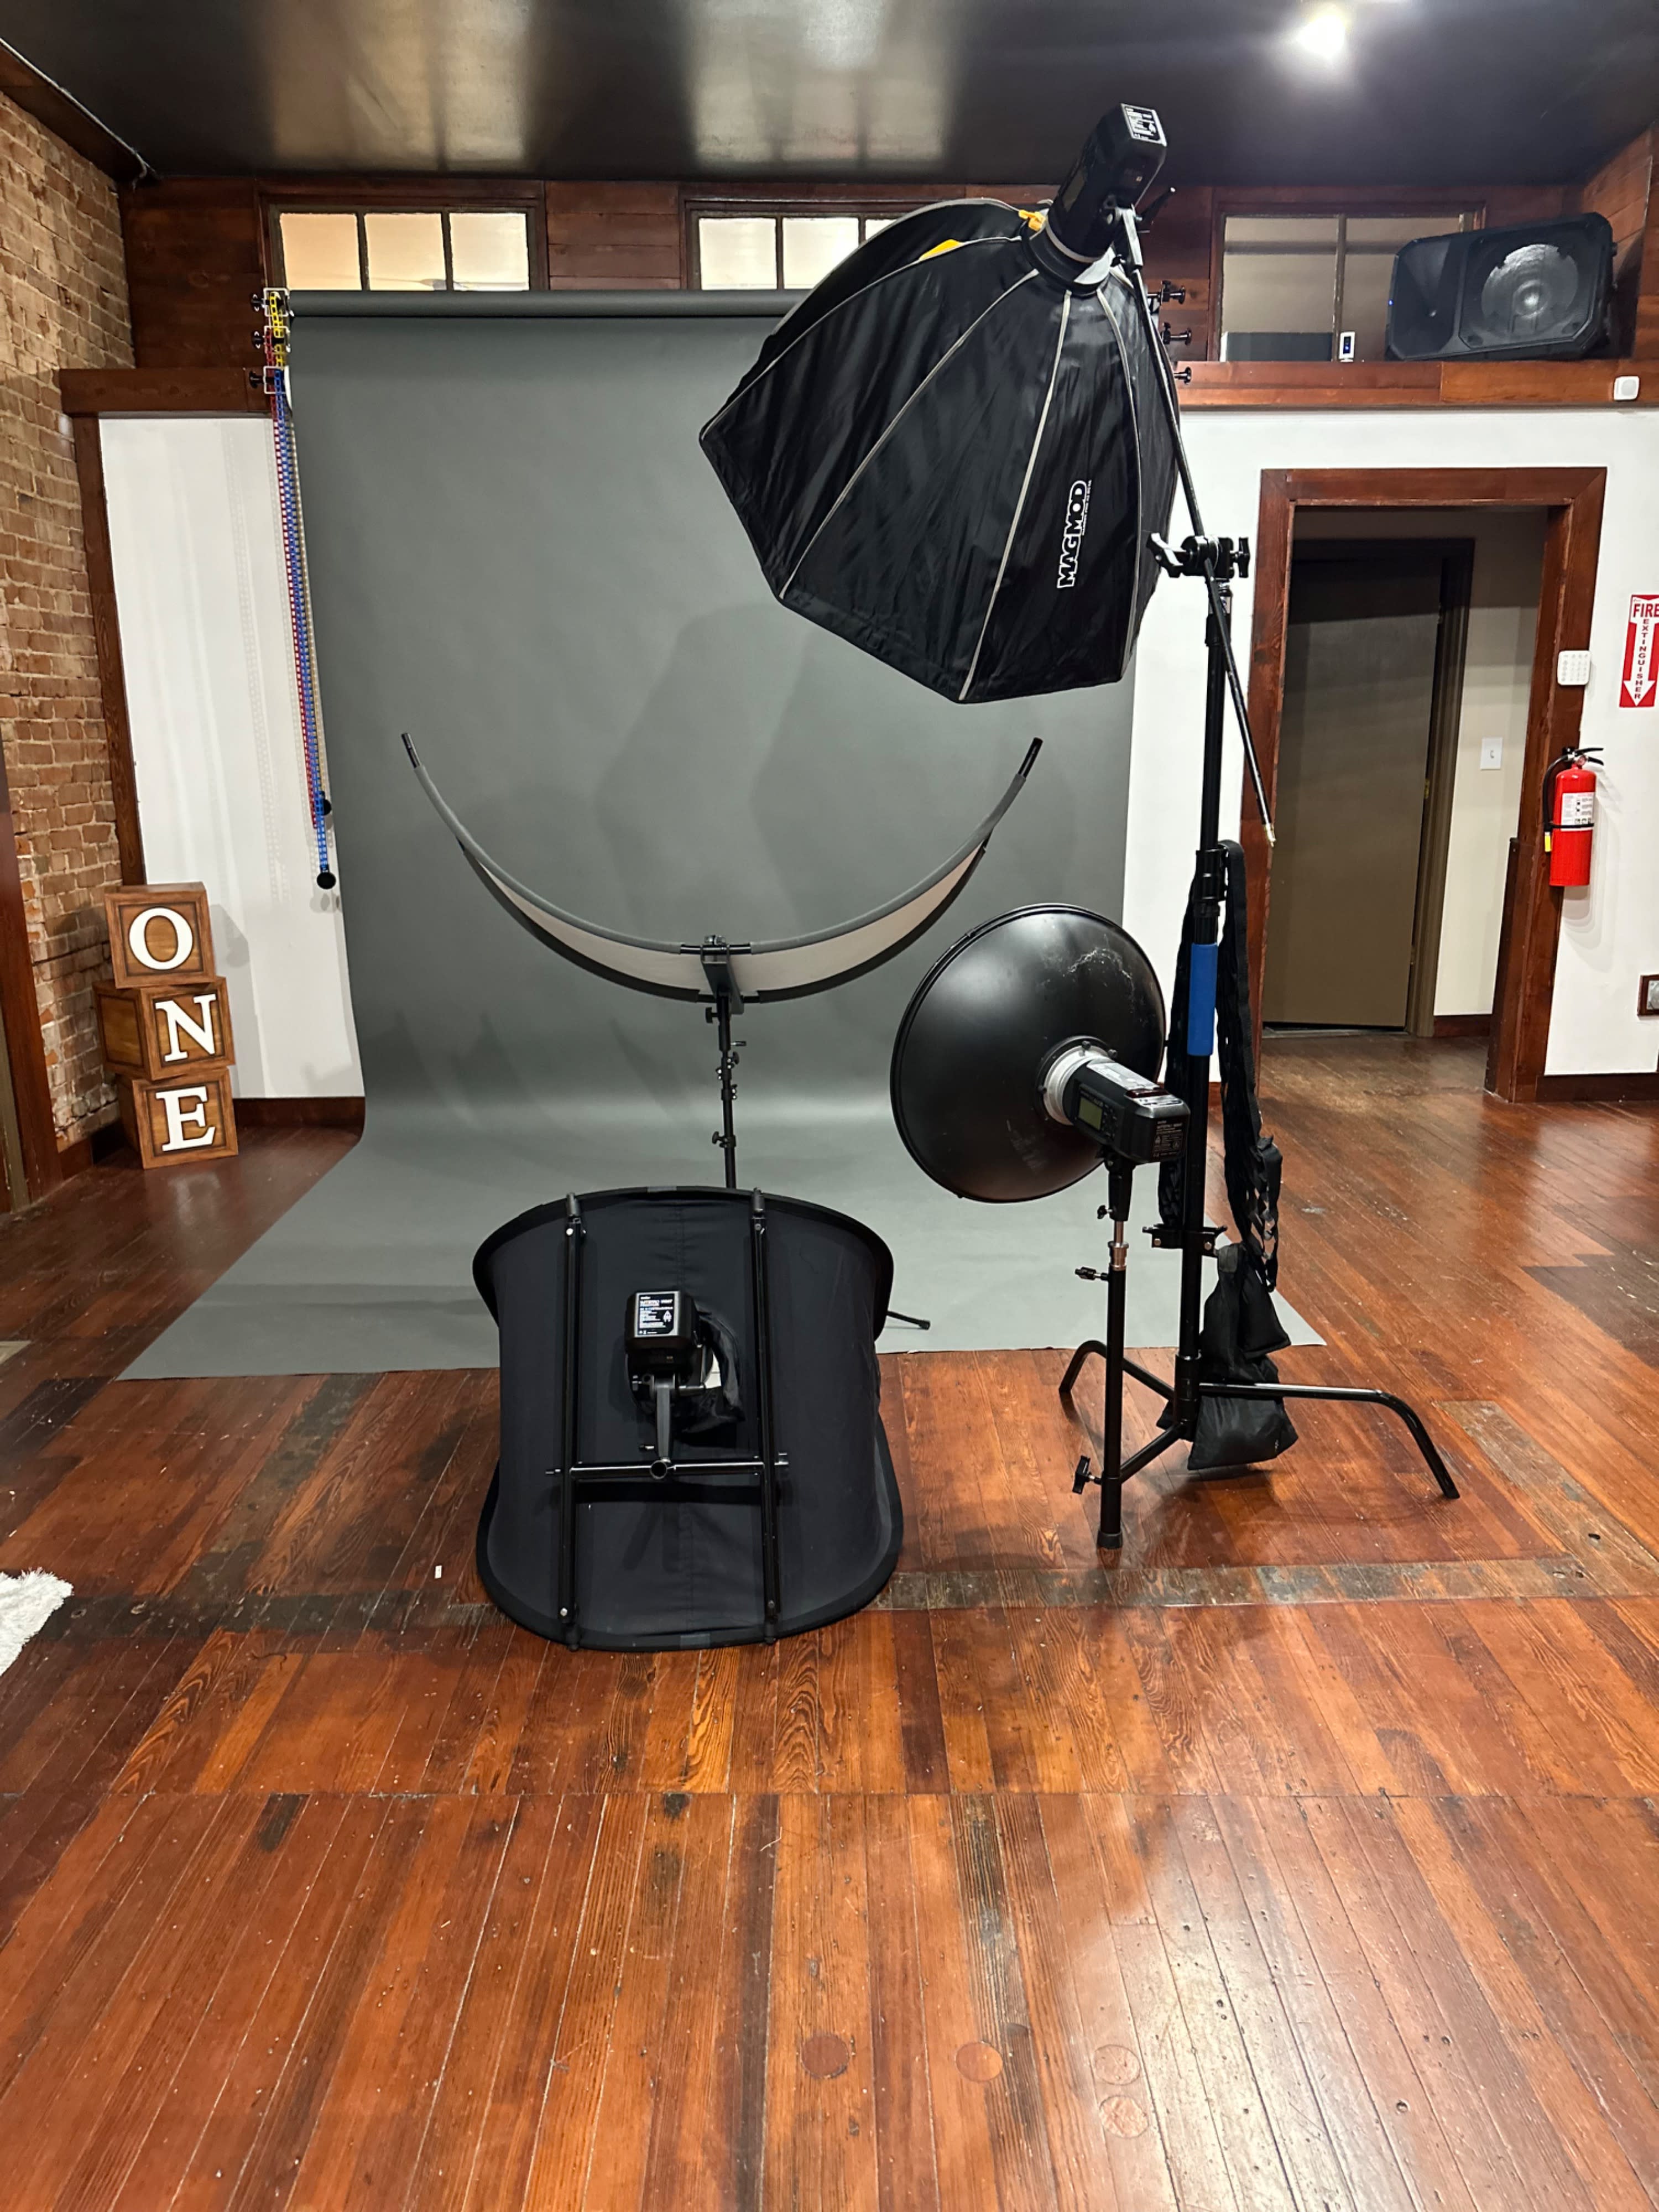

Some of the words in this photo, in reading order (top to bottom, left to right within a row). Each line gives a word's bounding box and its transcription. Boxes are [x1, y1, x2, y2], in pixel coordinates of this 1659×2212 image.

[1057, 481, 1087, 588] MAGMOD
[1633, 603, 1659, 617] FIRE
[1634, 619, 1649, 699] EXTINGUISHER
